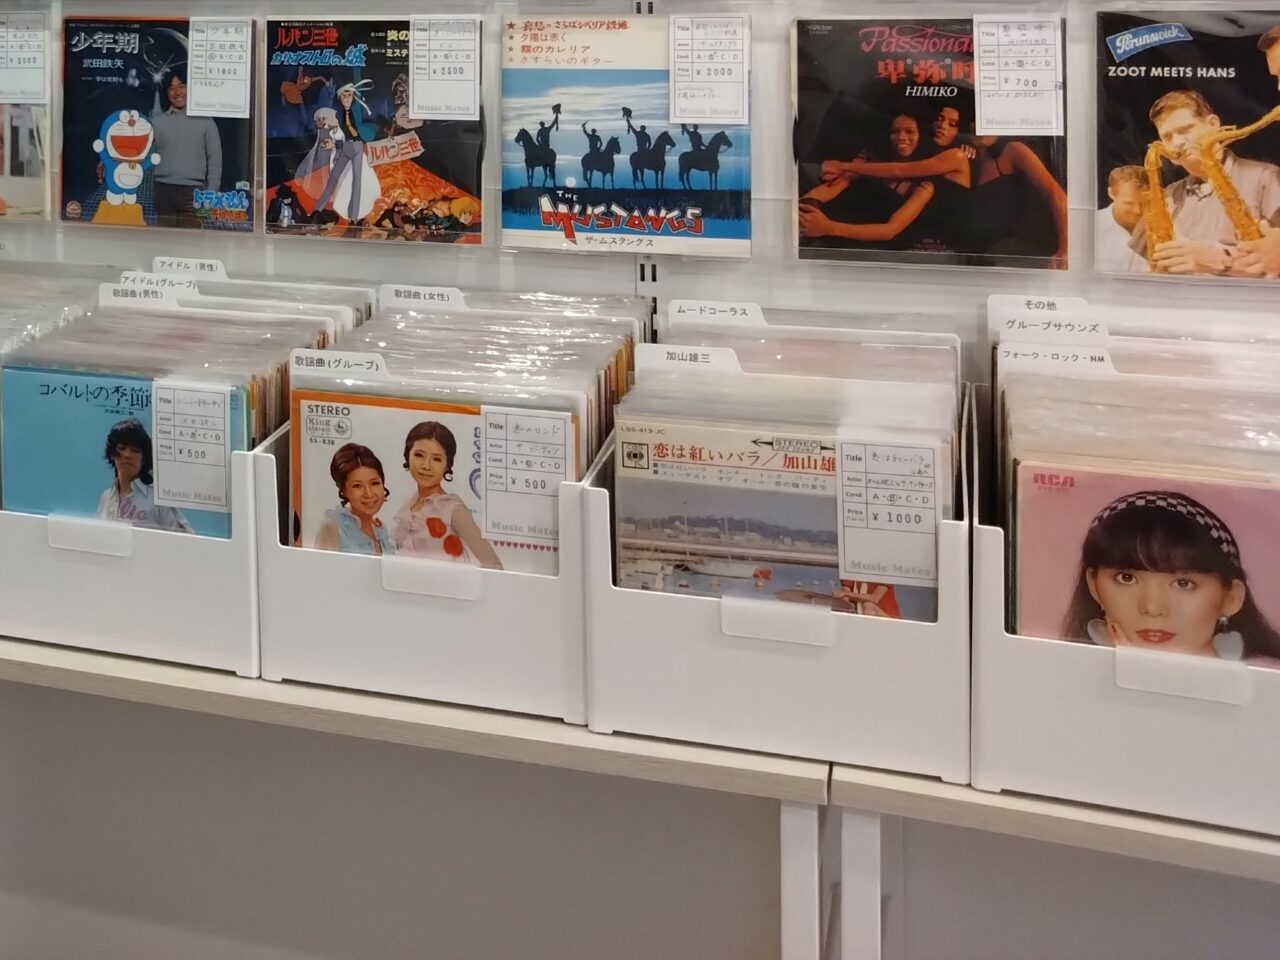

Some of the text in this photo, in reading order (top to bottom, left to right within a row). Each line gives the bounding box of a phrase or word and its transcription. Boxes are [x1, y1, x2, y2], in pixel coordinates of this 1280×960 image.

[72, 31, 140, 54] 少年期
[275, 27, 339, 49] ルパン三世
[520, 33, 566, 43] 夕陽は赤く
[270, 43, 369, 67] カリオストロの城
[521, 45, 590, 54] 霧のカレリア
[83, 58, 125, 69] 武田鉄矢
[520, 56, 616, 65] さすらいのギター
[441, 67, 464, 76] 2500
[707, 67, 733, 77] 2000
[1108, 66, 1236, 78] ZOOT MEETS HANS
[1015, 78, 1038, 88] 700
[905, 86, 958, 97] HIMIKO
[370, 138, 422, 164] ルパン三世
[556, 189, 578, 201] THE
[539, 193, 704, 245] MUSTANGS
[677, 304, 749, 318] ムードコーラス
[1024, 299, 1058, 312] その他
[1006, 318, 1101, 334] グループサウンズ
[665, 350, 712, 365] 加山雄三
[39, 383, 152, 408] コバルトの季節
[307, 404, 351, 416] STEREO
[308, 417, 331, 427] King
[488, 422, 504, 431] Title
[773, 438, 820, 449] STEREO
[187, 448, 207, 460] 500
[844, 454, 863, 463] Title
[510, 476, 546, 490] ¥ 500
[1033, 473, 1076, 488] RCA
[162, 488, 222, 502] Music Mates
[872, 511, 922, 525] ¥ 1000
[491, 520, 524, 532] Music
[851, 560, 931, 577] Music Mates
